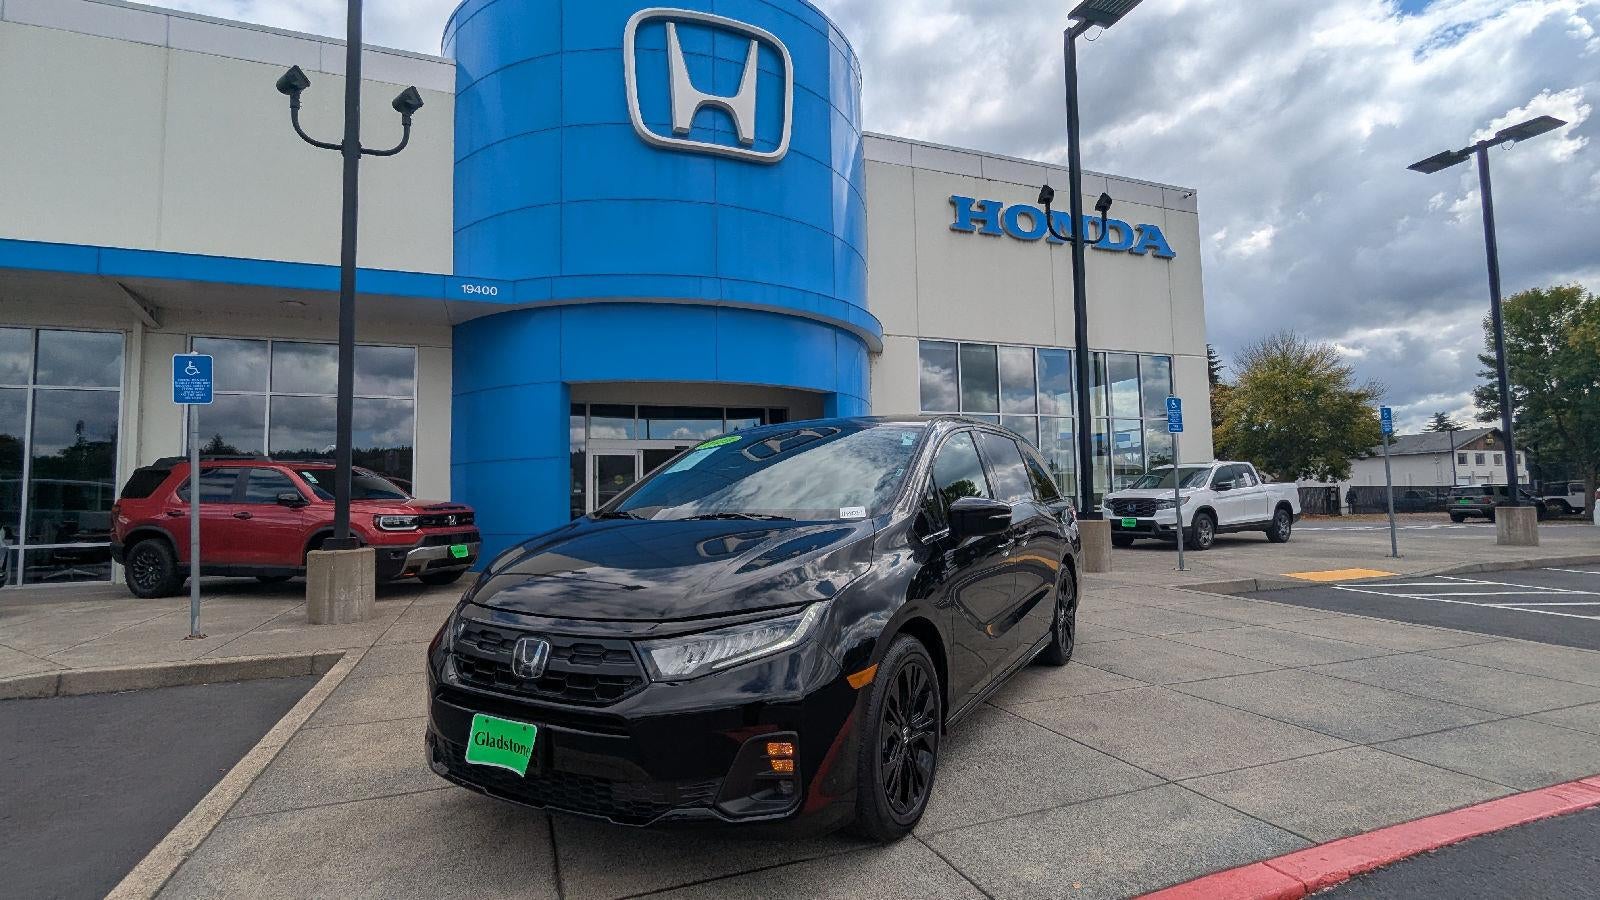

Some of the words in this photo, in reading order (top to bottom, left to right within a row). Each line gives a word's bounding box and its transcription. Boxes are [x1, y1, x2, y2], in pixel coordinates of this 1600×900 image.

[948, 194, 1176, 259] HONDA
[460, 284, 498, 296] 19400
[474, 731, 531, 758] Gladstone
